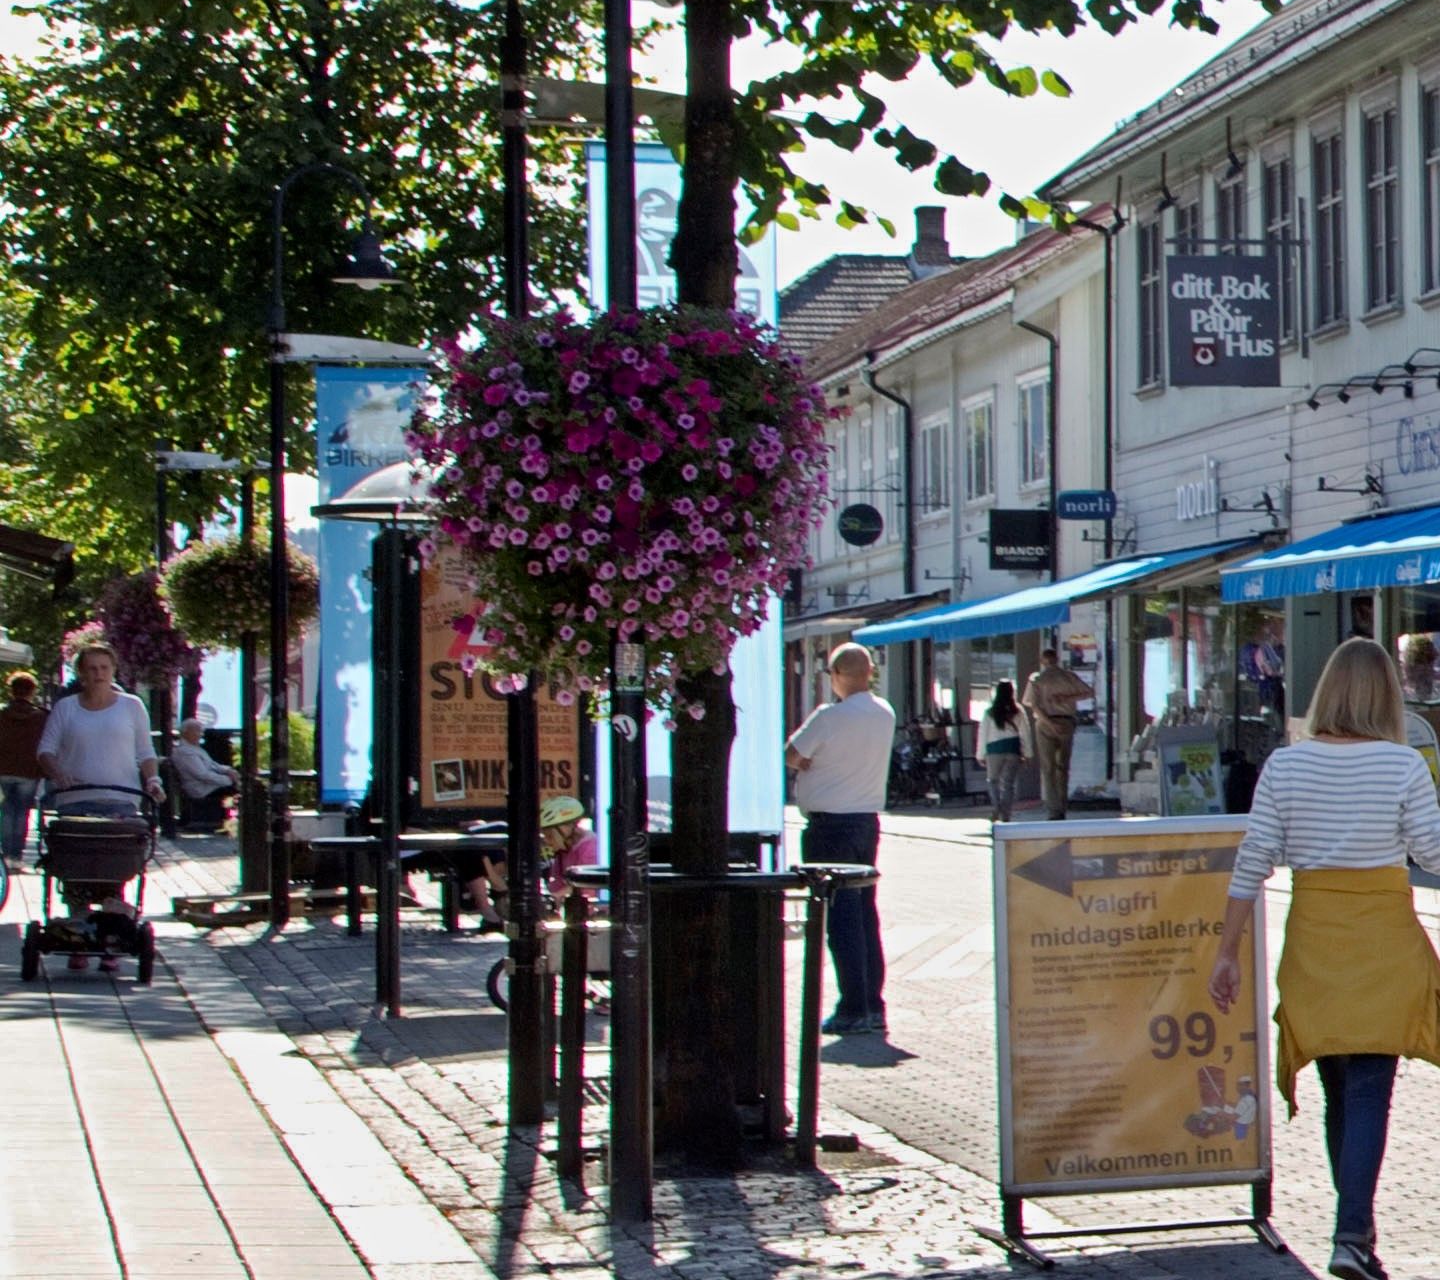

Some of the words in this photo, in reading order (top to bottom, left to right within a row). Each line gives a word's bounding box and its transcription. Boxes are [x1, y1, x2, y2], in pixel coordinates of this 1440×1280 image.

[1171, 272, 1215, 300] ditt
[1221, 274, 1271, 300] Bok
[1208, 294, 1232, 320] &
[1190, 308, 1253, 340] Papir
[1225, 333, 1275, 357] Hus
[1175, 453, 1220, 522] norli
[1064, 497, 1112, 515] norli
[464, 760, 572, 789] NIKRS
[1117, 854, 1208, 877] Smuget
[1078, 890, 1158, 918] Valgfri
[1031, 919, 1240, 950] middagstallerke
[1149, 1011, 1256, 1064] 99,-
[1045, 1148, 1190, 1178] Velkommen
[1196, 1146, 1234, 1164] inn
